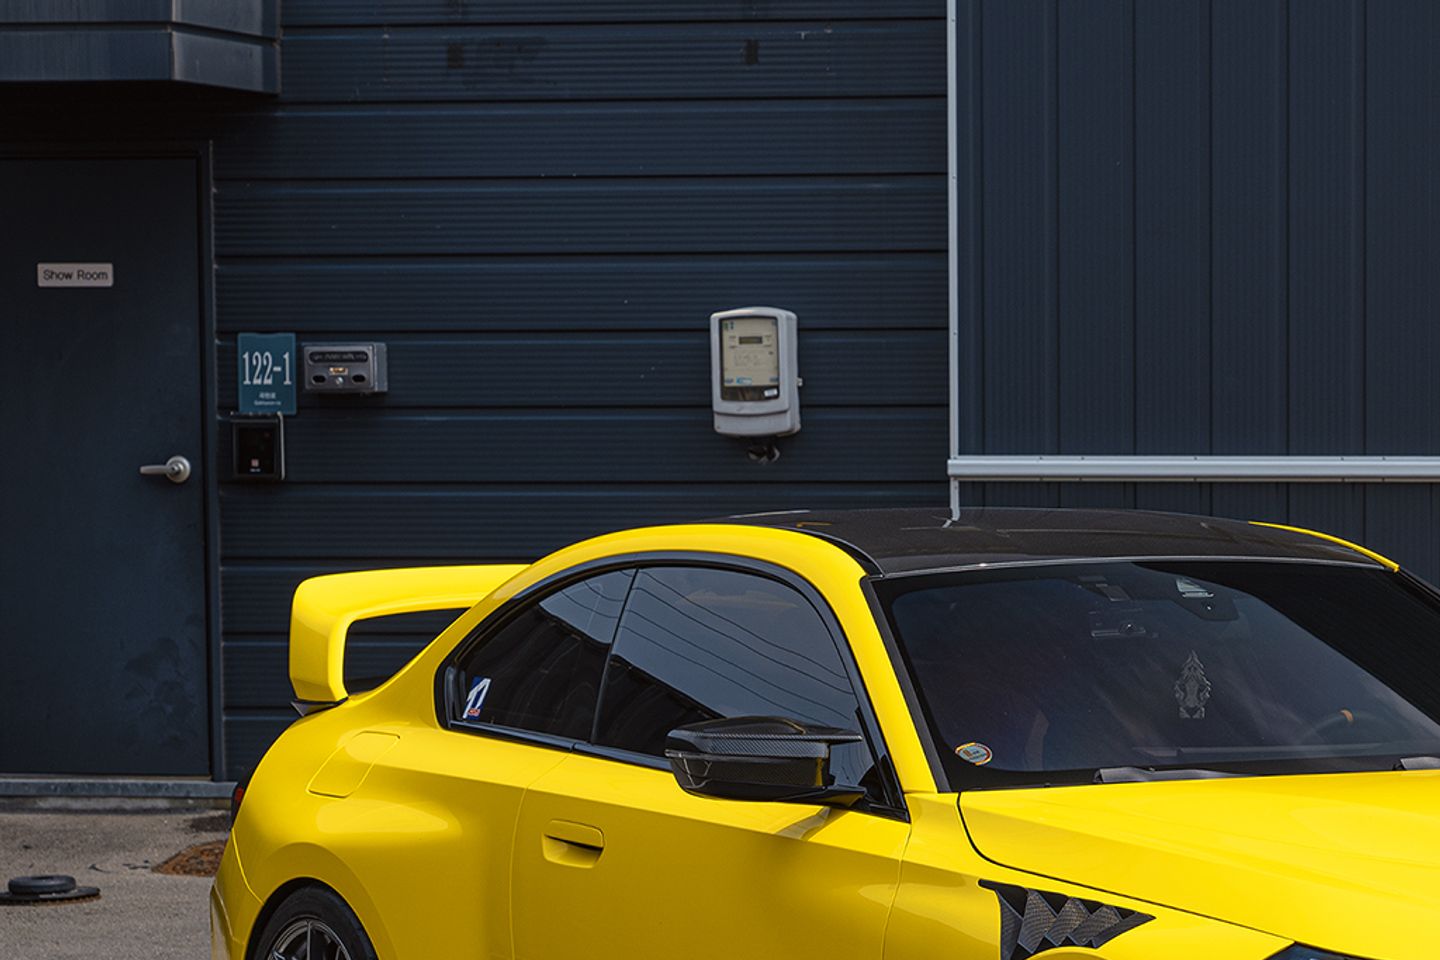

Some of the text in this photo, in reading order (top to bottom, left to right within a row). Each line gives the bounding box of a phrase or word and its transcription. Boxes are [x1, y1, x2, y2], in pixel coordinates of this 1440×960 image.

[43, 268, 109, 281] Show Room
[242, 351, 292, 385] 122-1
